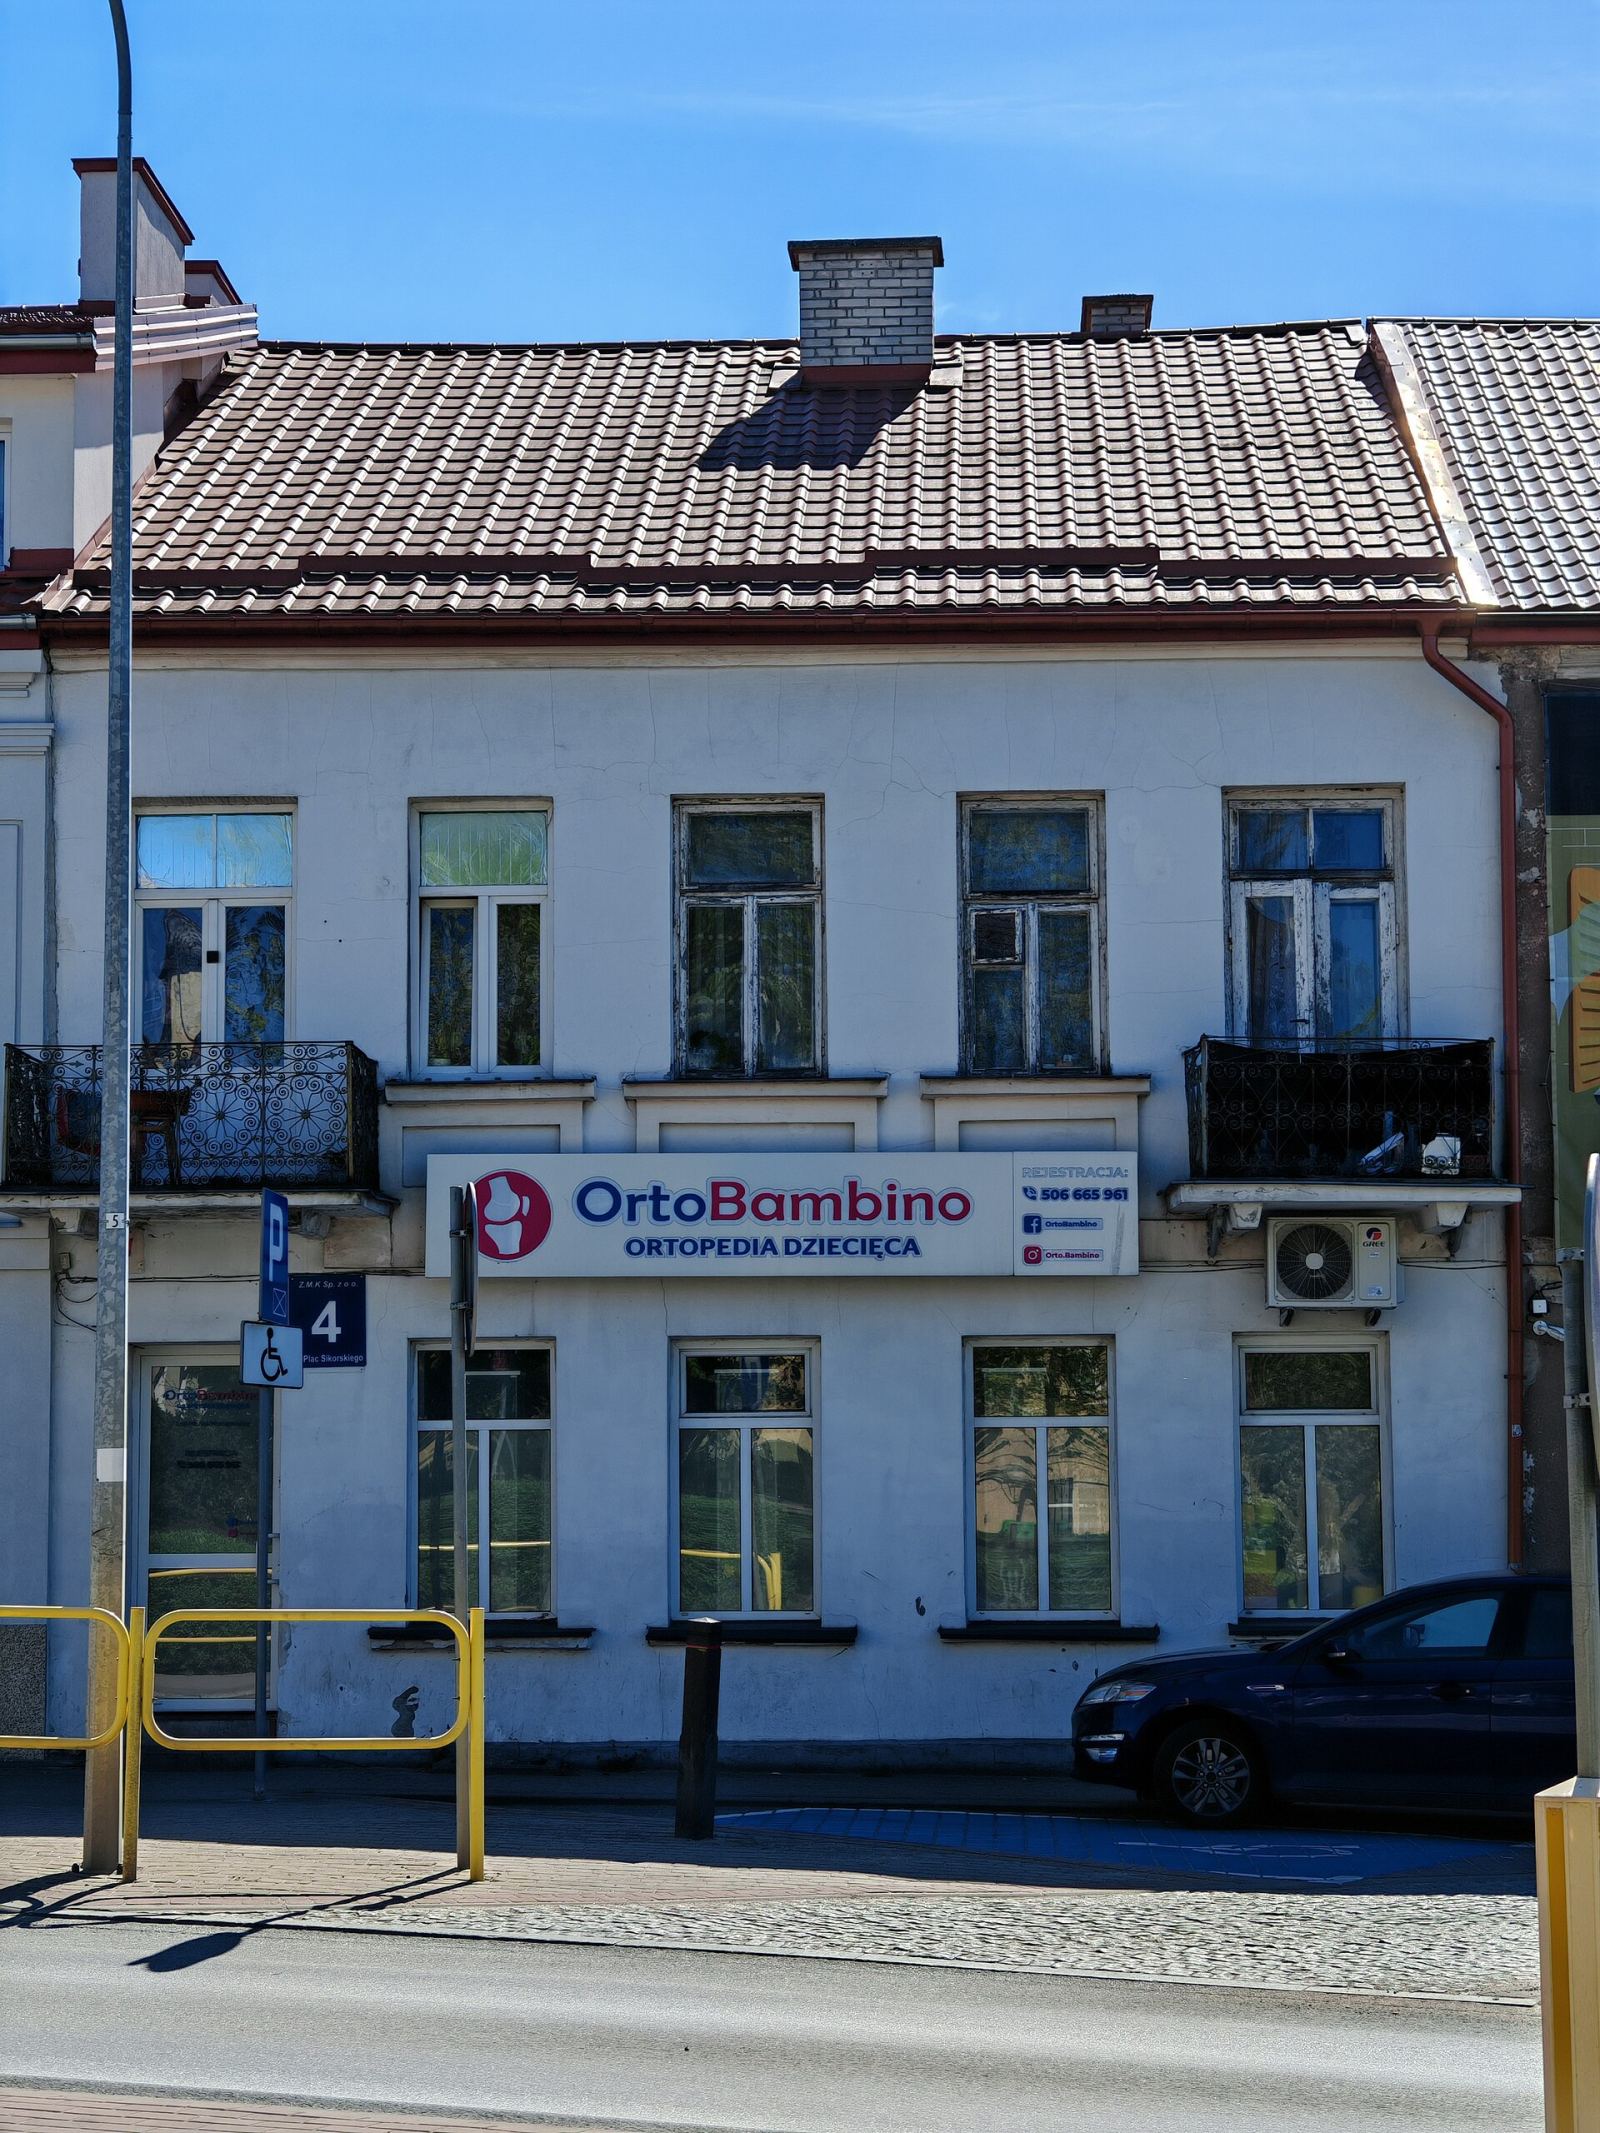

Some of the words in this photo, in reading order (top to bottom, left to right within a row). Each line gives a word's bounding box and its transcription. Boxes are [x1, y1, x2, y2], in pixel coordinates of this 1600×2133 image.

[1022, 1167, 1129, 1178] REJESTRACJA:
[576, 1180, 972, 1222] OrtoBambino
[1041, 1188, 1069, 1201] 506
[1073, 1188, 1100, 1201] 665
[1103, 1188, 1129, 1201] 961
[112, 1214, 118, 1228] 5
[1045, 1220, 1098, 1228] OrtoBambino
[269, 1202, 284, 1282] P
[625, 1237, 778, 1256] ORTOPEDIA
[784, 1237, 921, 1260] DZIECIĘCA
[1046, 1251, 1100, 1259] Orto.Bambino
[311, 1300, 342, 1343] 4
[303, 1355, 319, 1363] Plac
[320, 1354, 364, 1363] Sikorskiego
